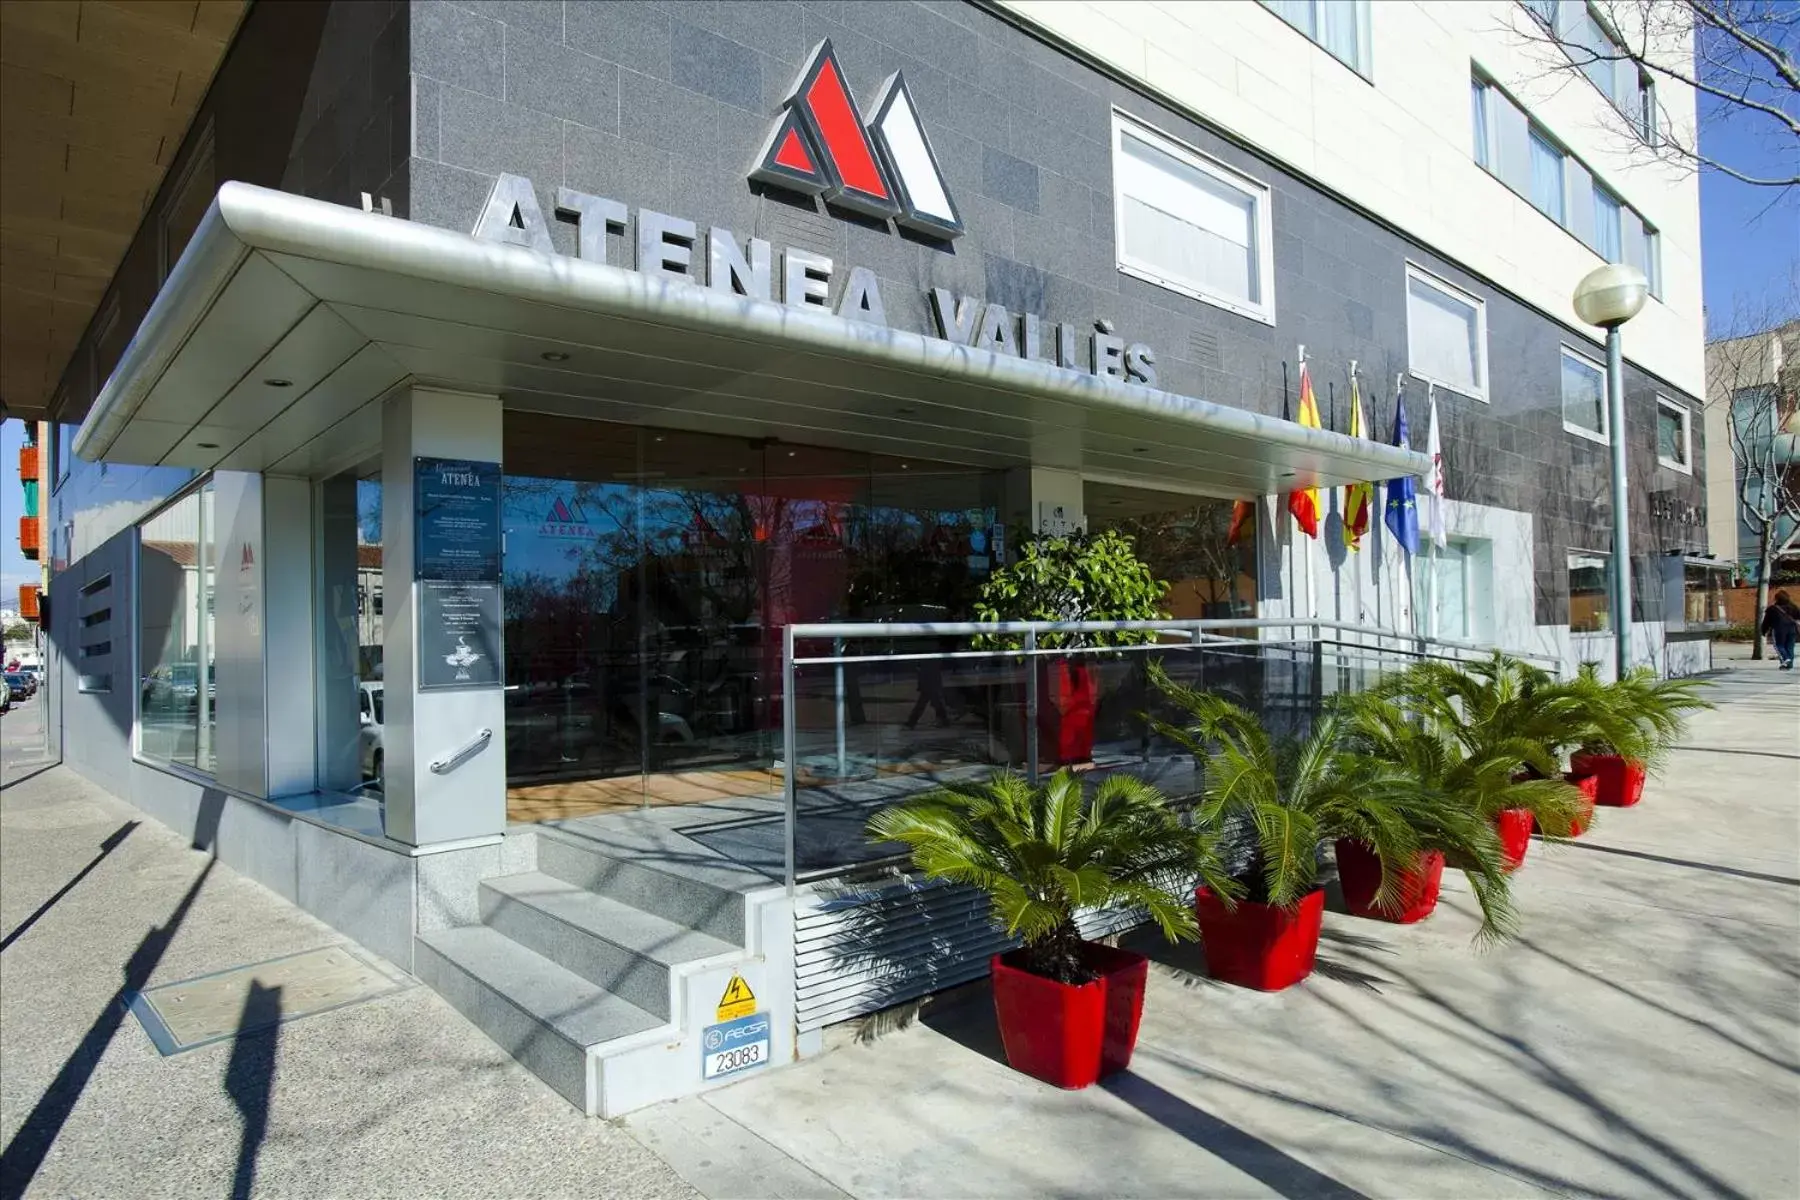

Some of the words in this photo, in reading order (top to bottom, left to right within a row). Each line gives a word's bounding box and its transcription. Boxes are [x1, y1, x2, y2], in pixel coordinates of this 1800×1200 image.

[472, 173, 889, 327] ATENEA
[928, 288, 1158, 385] VALLÈS
[538, 524, 595, 538] ATENEA
[716, 1044, 759, 1073] 23083
